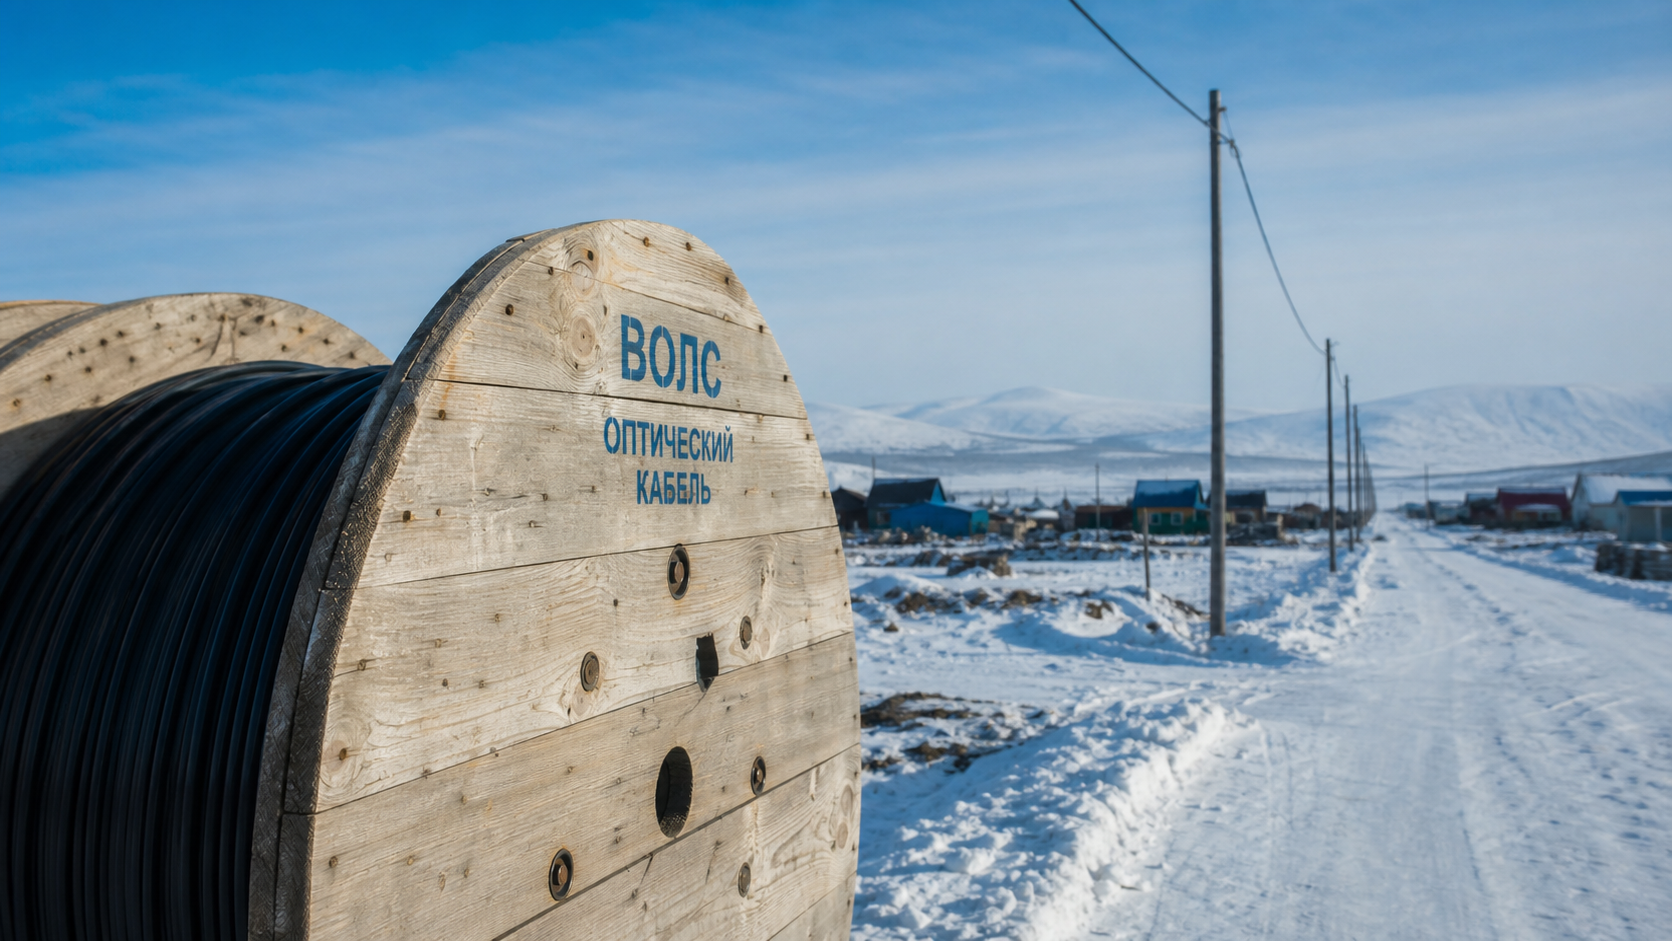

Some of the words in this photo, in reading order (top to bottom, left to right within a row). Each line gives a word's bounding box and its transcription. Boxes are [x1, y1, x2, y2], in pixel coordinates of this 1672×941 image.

[621, 314, 722, 399] ВОЛС
[603, 416, 734, 463] ОПТИЧЕСКИЙ
[636, 469, 711, 505] КАБЕЛЬ
